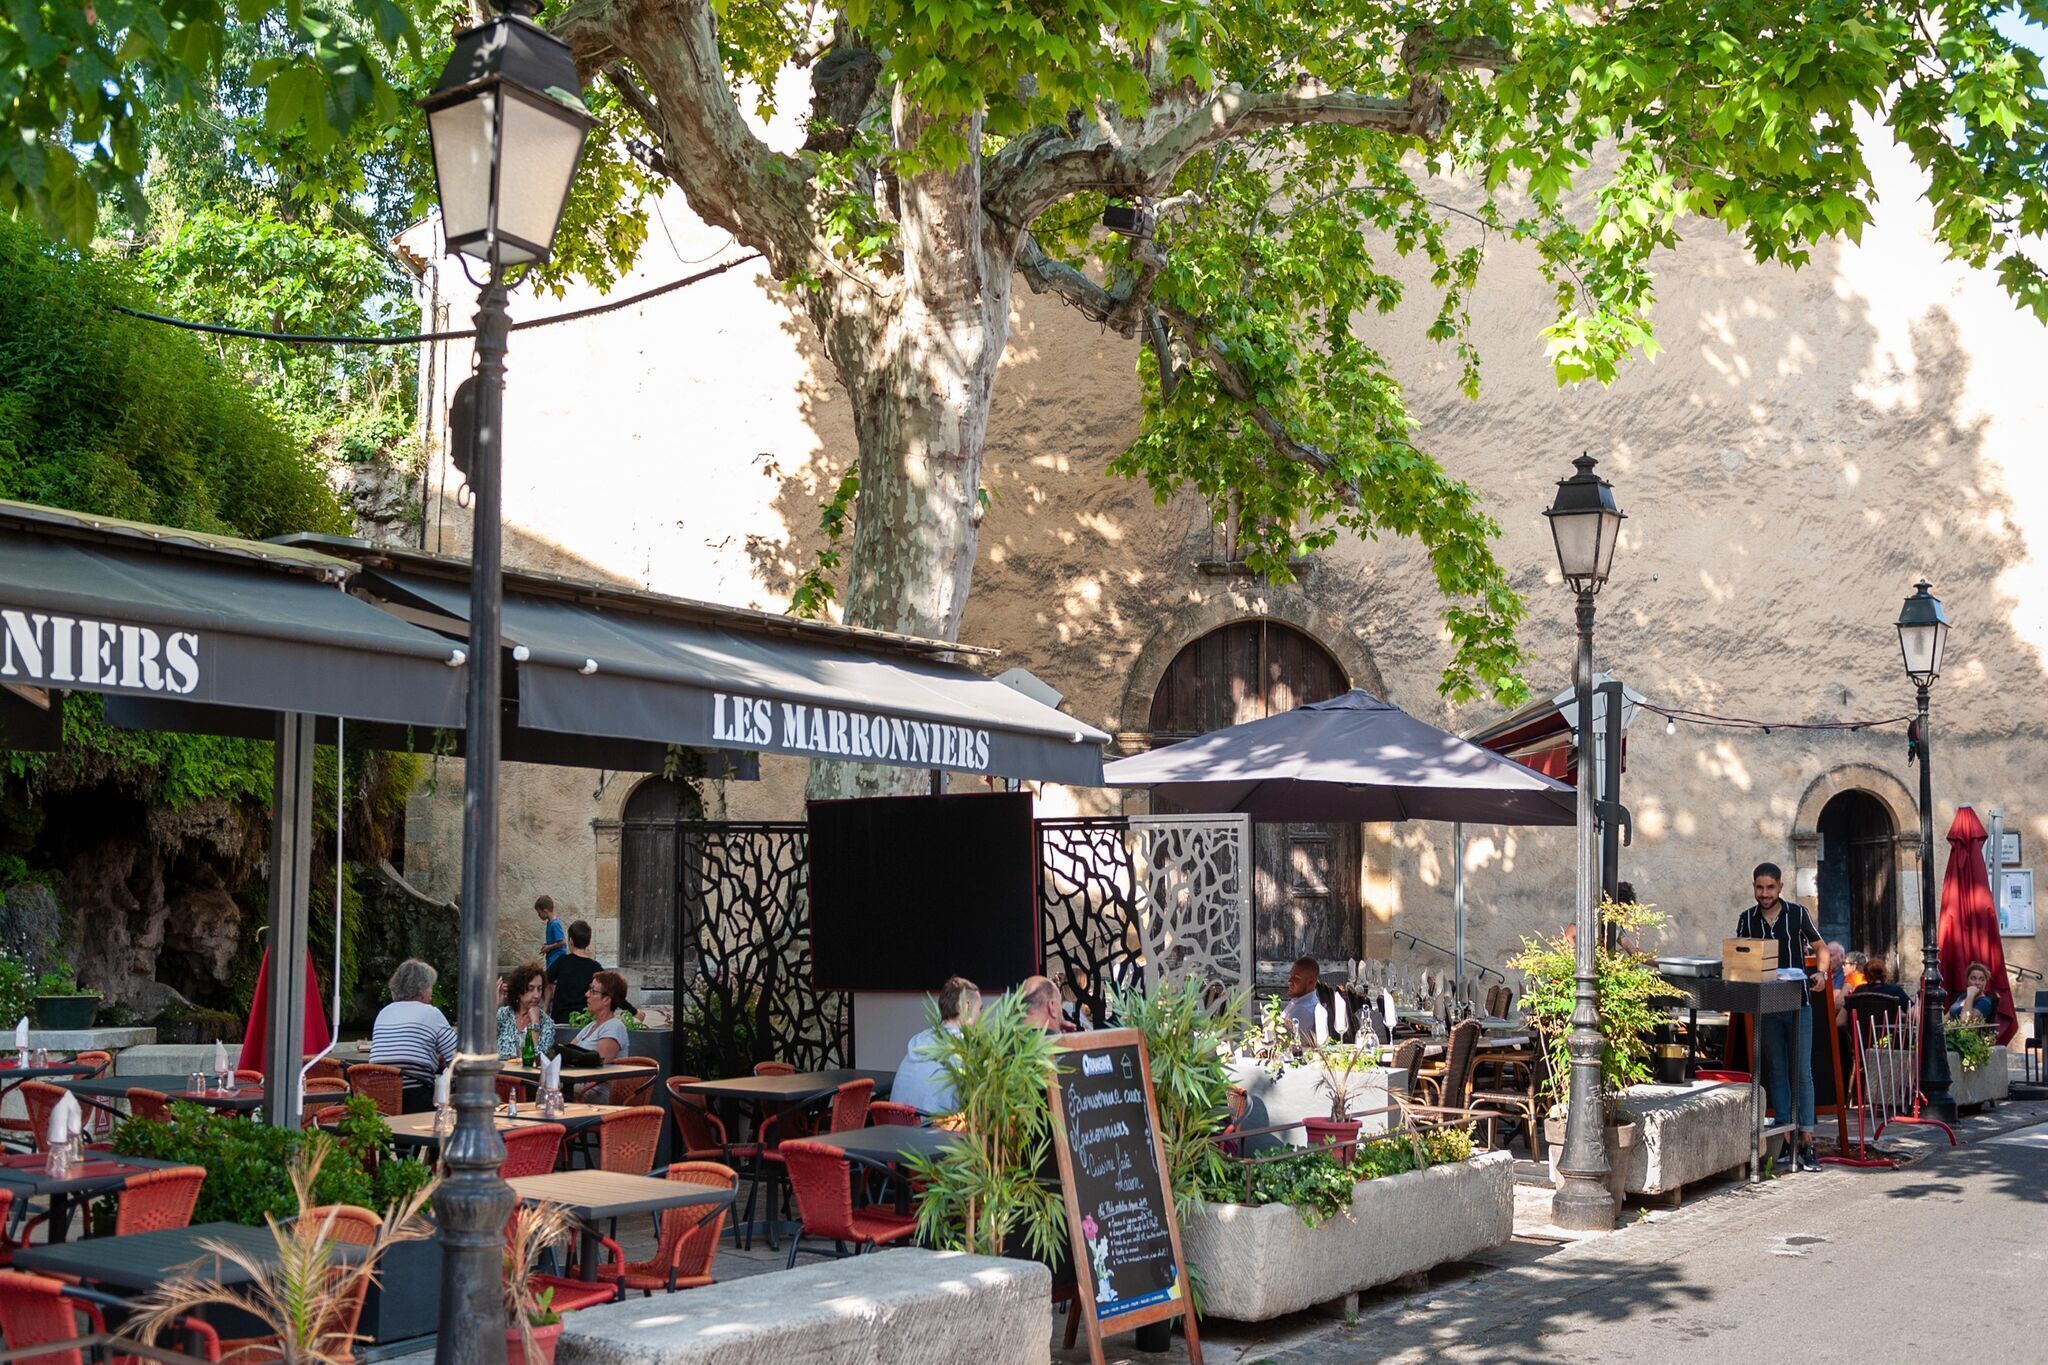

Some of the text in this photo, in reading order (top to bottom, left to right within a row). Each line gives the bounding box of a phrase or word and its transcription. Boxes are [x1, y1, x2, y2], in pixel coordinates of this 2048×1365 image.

[712, 692, 990, 770] LES MARRONNIERS
[1123, 1088, 1142, 1103] aux
